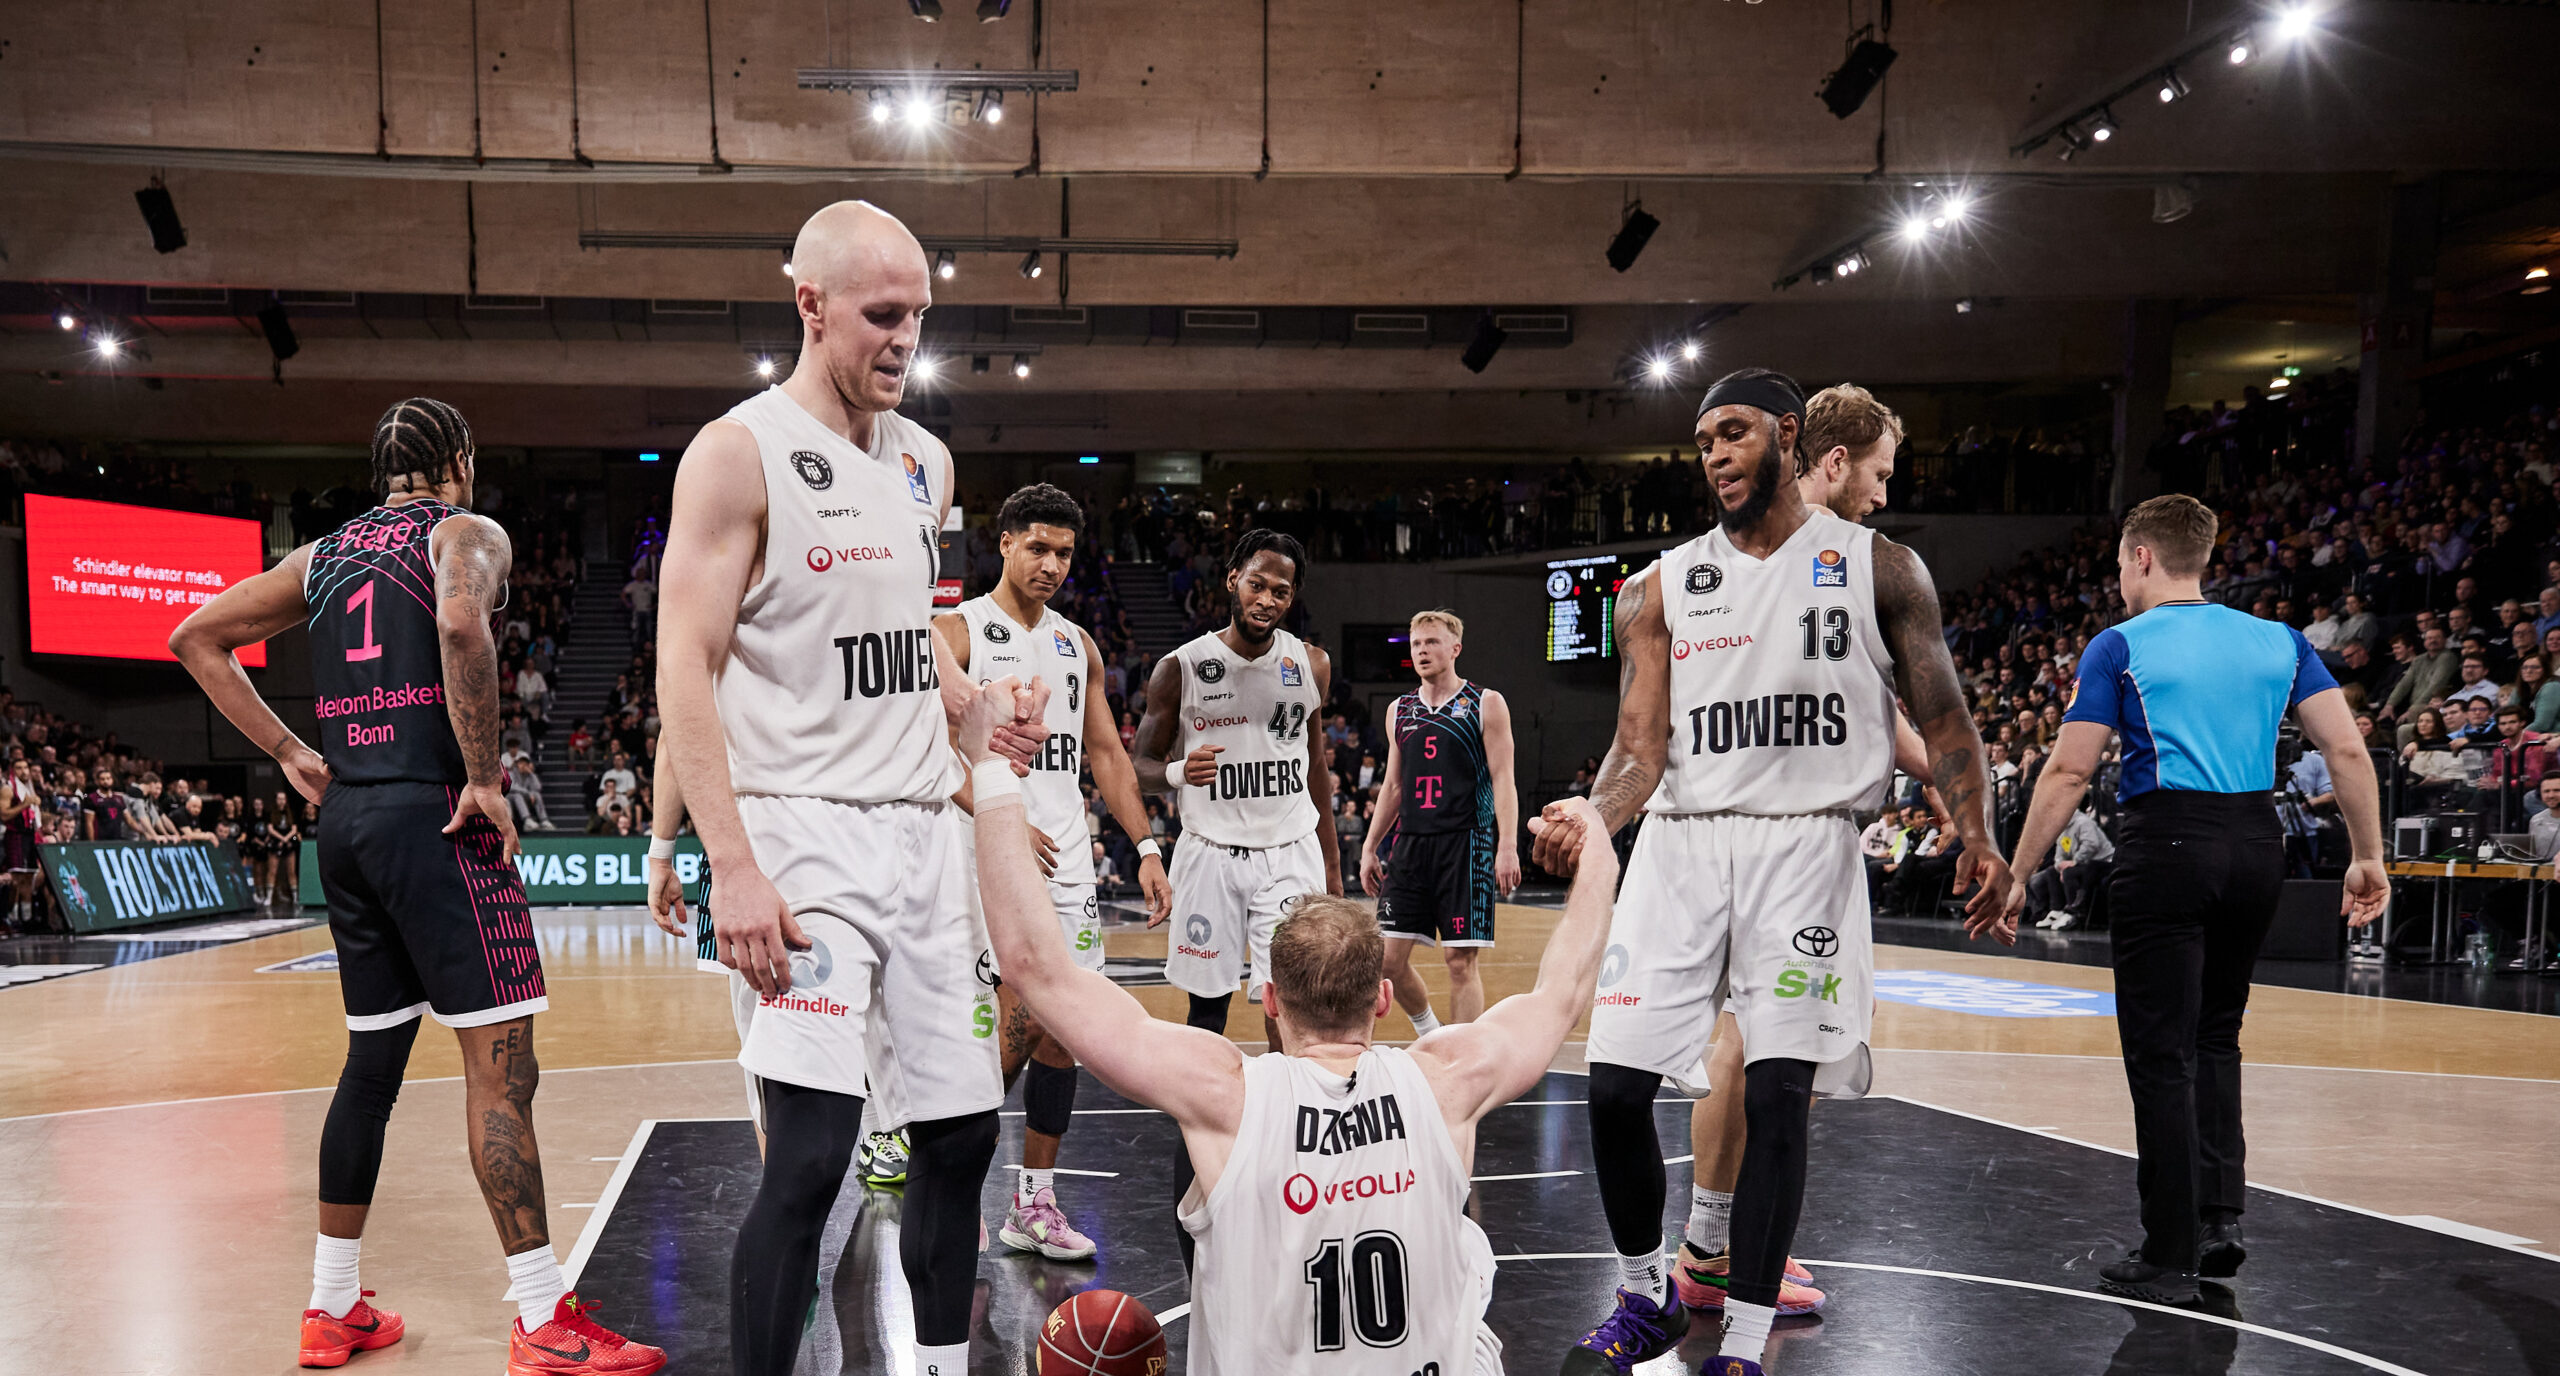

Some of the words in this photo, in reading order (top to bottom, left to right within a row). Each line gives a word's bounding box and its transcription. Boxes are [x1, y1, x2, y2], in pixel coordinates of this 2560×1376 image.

[817, 509, 850, 518] CRAFT
[836, 547, 894, 563] VEOLIA
[73, 557, 132, 577] Schindler
[133, 563, 183, 582] elevator
[185, 570, 226, 587] media.
[1580, 567, 1595, 580] 41
[1816, 576, 1843, 585] BBL
[52, 576, 78, 593] The
[81, 581, 117, 597] smart
[119, 585, 146, 602] way
[149, 587, 162, 601] to
[165, 589, 186, 605] get
[346, 580, 382, 662] 1
[1688, 607, 1723, 618] CRAFT
[1694, 635, 1753, 652] VEOLIA
[1799, 606, 1852, 661] 13
[1066, 672, 1079, 713] 3
[1284, 677, 1300, 685] BBL
[1203, 693, 1227, 701] CRAFT
[1207, 716, 1249, 728] VEOLIA
[1268, 702, 1306, 740] 42
[1688, 692, 1847, 756] TOWERS
[347, 723, 395, 747] Bonn
[1424, 736, 1437, 759] 5
[513, 853, 588, 886] WAS
[94, 845, 224, 920] HOLSTEN
[1177, 945, 1220, 959] Schindler
[1783, 959, 1835, 971] Autohaus
[1773, 969, 1843, 1005] S+K
[1819, 1024, 1839, 1034] CRAFT
[1324, 1169, 1415, 1205] VEOLIA
[1304, 1229, 1410, 1353] 10
